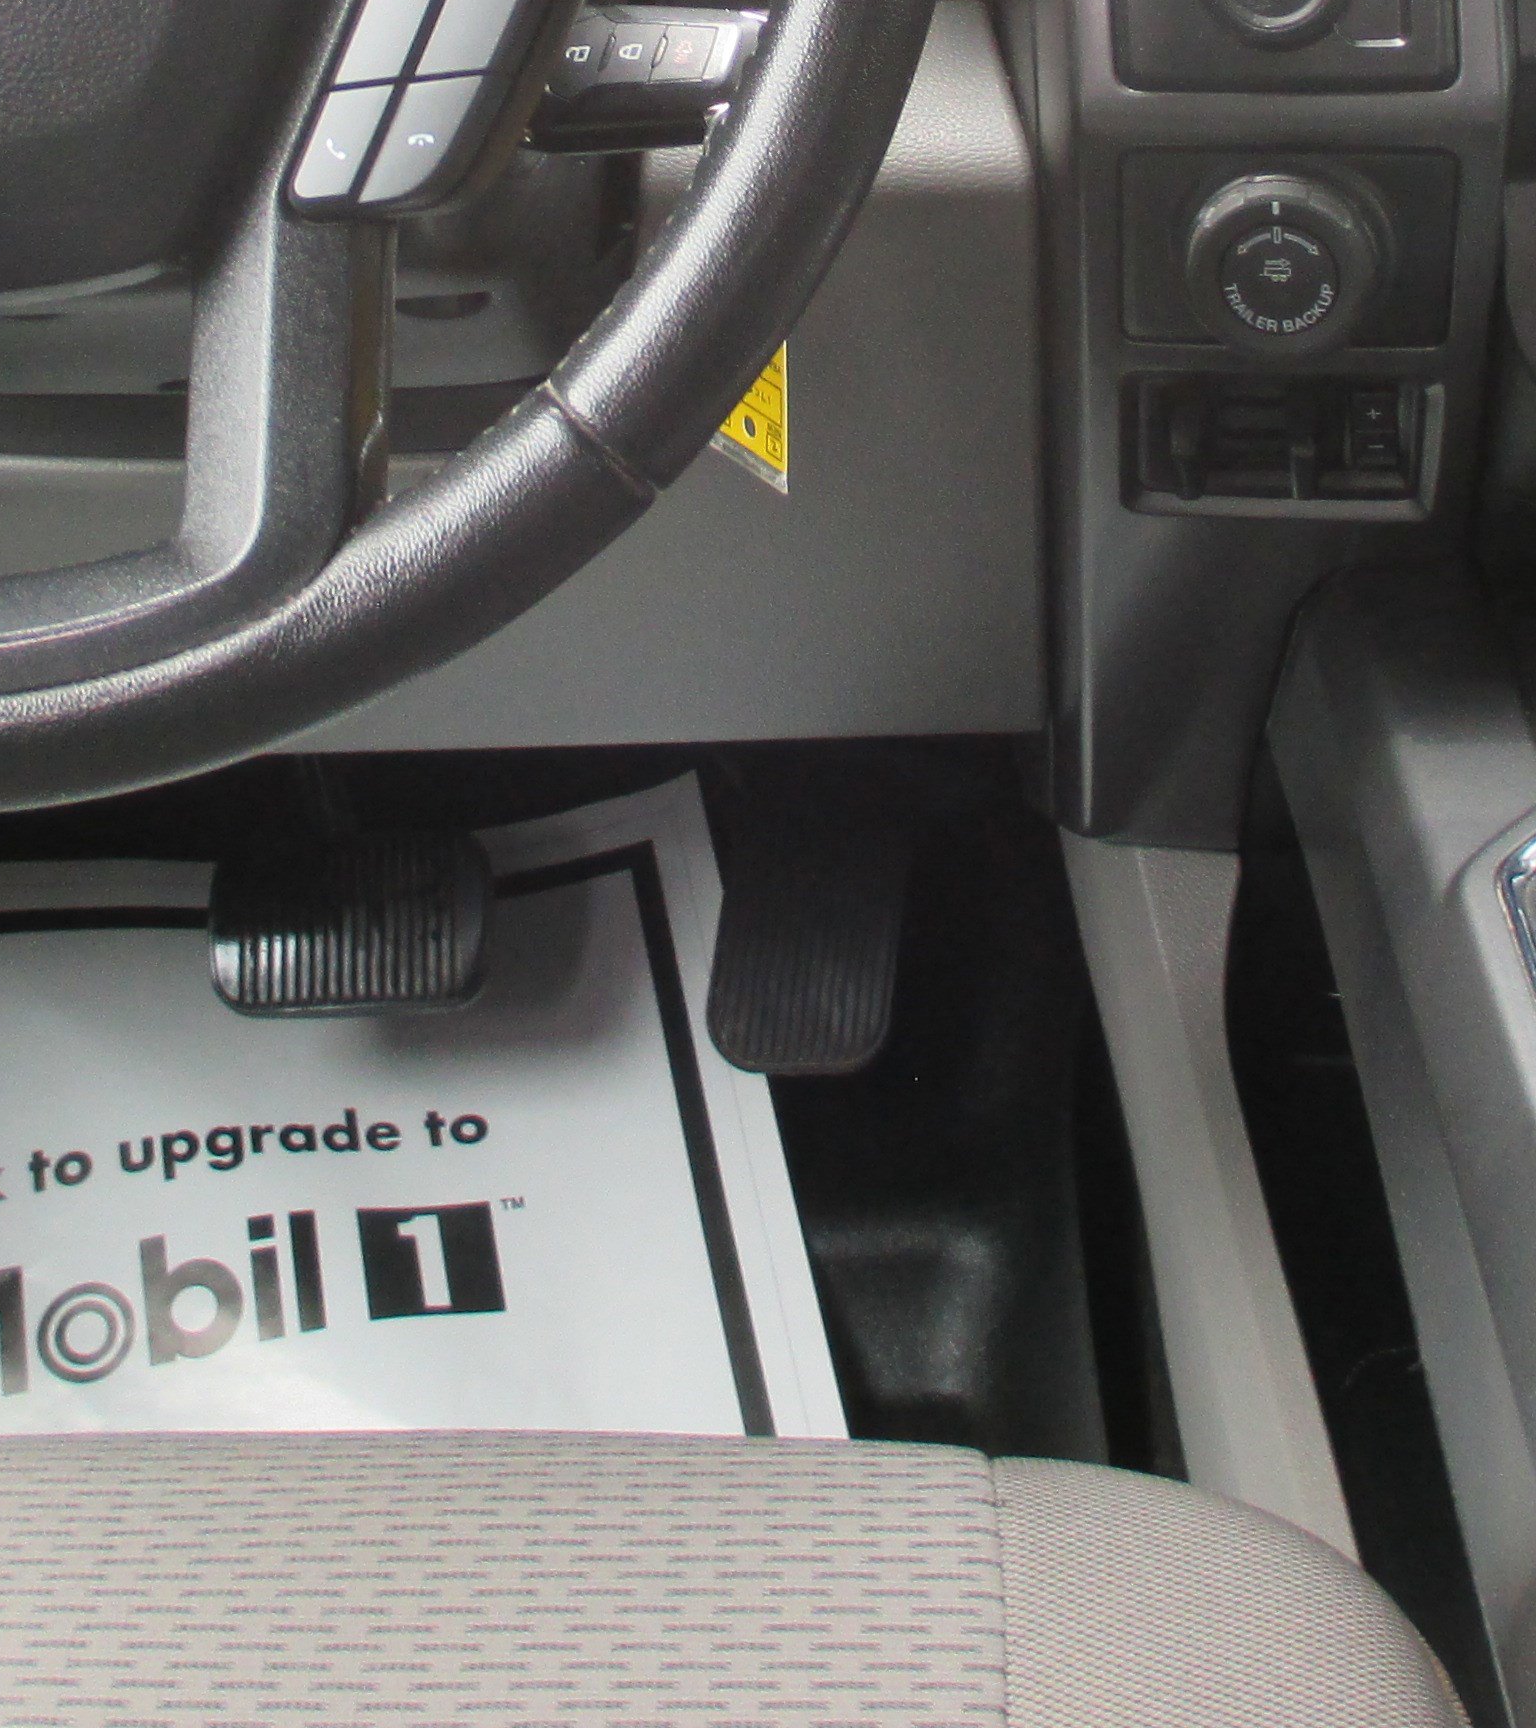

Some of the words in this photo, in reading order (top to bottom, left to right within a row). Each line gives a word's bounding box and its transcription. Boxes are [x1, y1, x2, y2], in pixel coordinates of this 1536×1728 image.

[1224, 282, 1279, 332] TRAILER
[1282, 283, 1335, 332] BACKUP
[28, 1147, 92, 1191] to
[118, 1108, 402, 1181] upgrade
[424, 1109, 489, 1148] to
